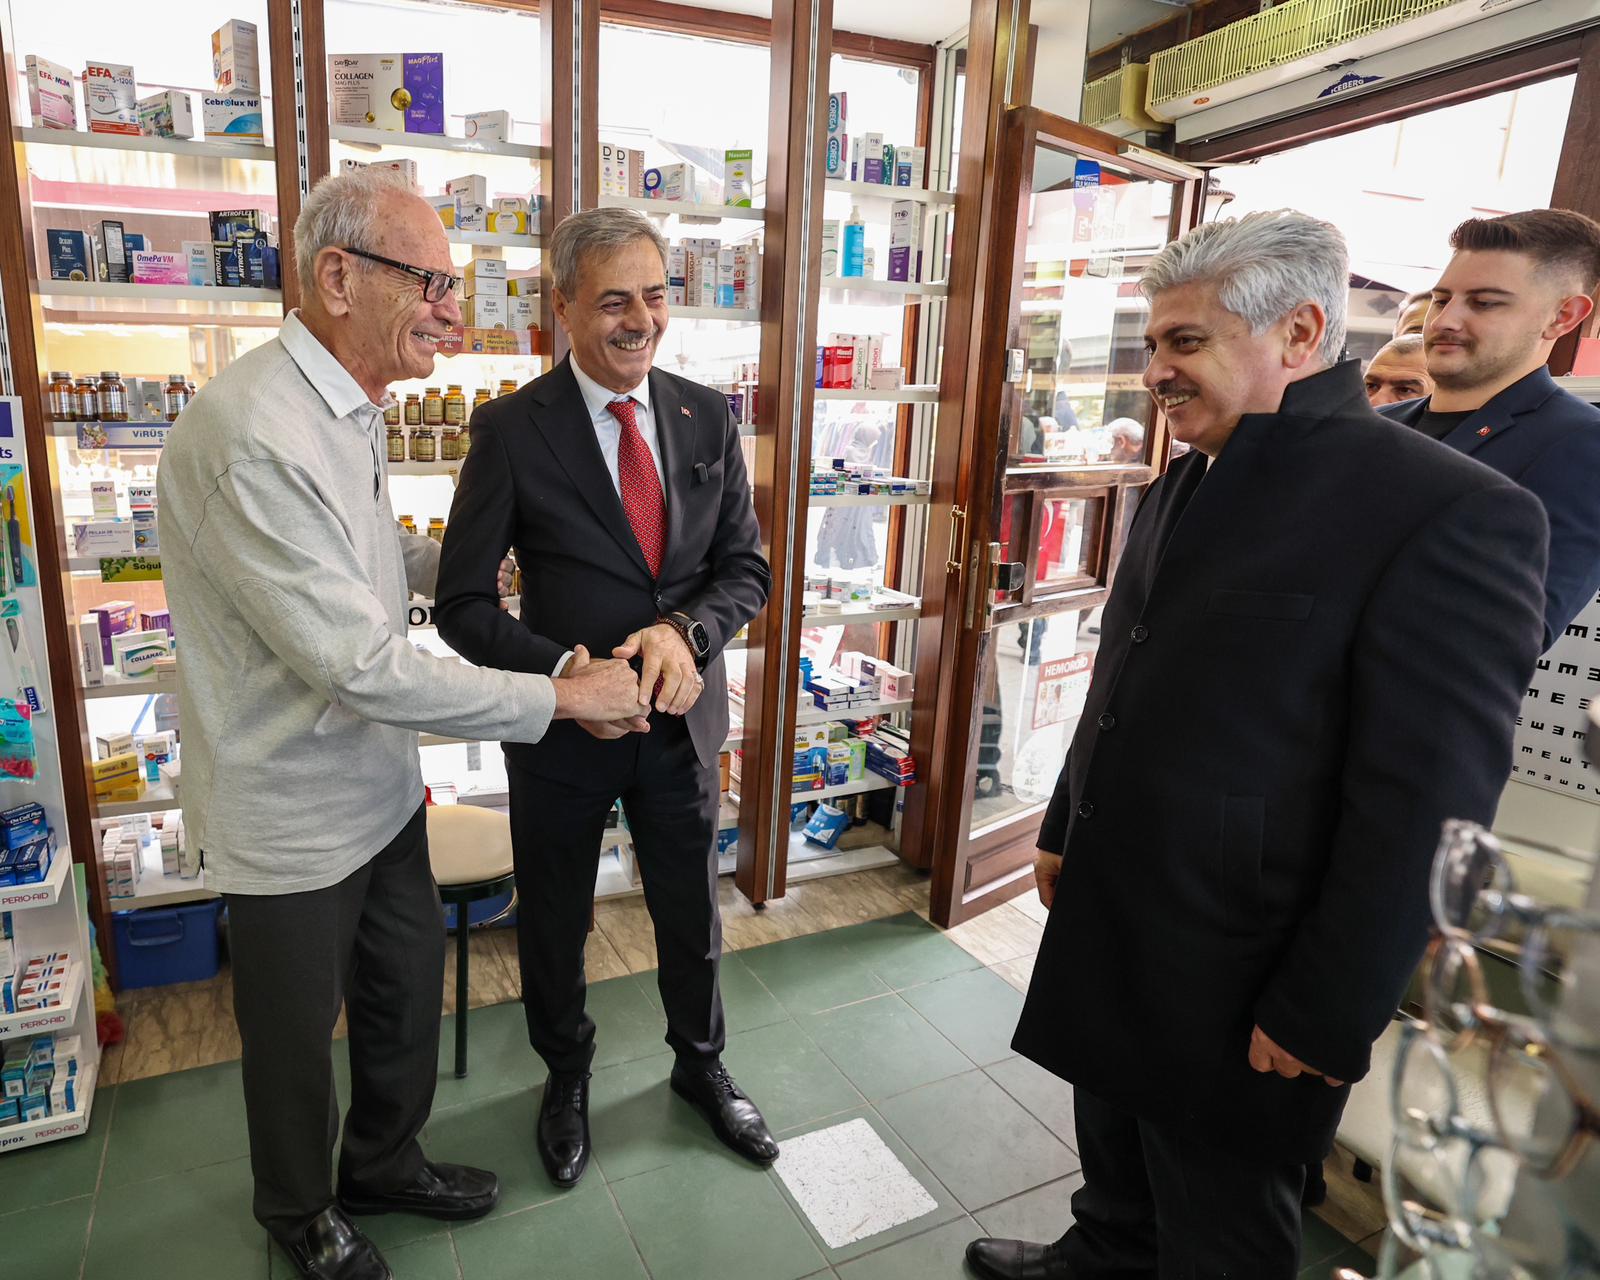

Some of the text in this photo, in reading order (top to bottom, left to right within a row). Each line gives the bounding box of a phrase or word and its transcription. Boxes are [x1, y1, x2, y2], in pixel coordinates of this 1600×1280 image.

[88, 67, 112, 78] EFA
[1330, 80, 1364, 94] ICEBERG
[204, 98, 246, 107] Cebrolux
[829, 140, 838, 170] COREGA
[2, 892, 48, 904] PERIO-AID
[20, 1016, 66, 1030] PERIO-AID
[35, 1124, 79, 1138] PERIO-AID
